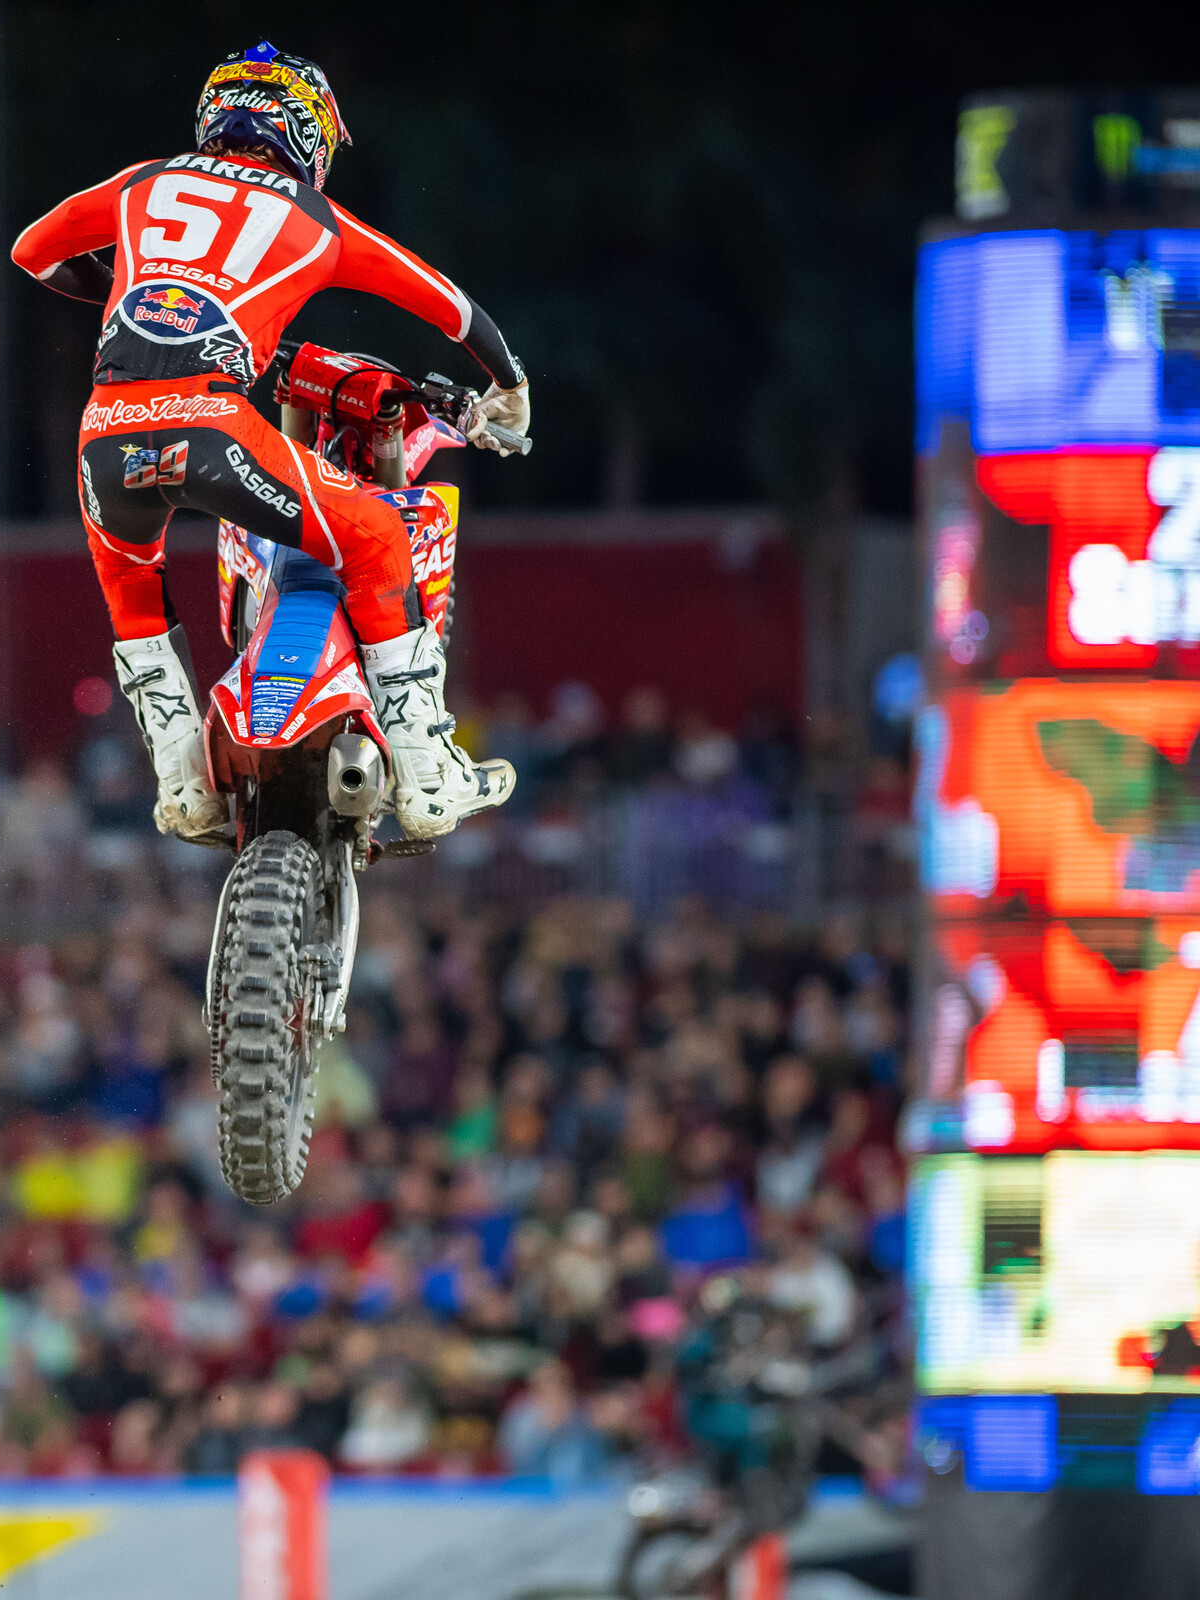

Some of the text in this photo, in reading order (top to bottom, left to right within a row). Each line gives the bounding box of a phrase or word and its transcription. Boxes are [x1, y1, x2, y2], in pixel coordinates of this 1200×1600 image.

[210, 88, 281, 114] Justin
[165, 154, 298, 198] BARCIA
[139, 174, 293, 284] 51
[139, 262, 235, 292] GASGAS
[134, 305, 199, 334] Red Bull
[294, 377, 368, 410] RENTHAL
[82, 393, 238, 432] Troy Lee Designs
[123, 439, 189, 489] 69
[225, 443, 302, 519] GASGAS
[146, 640, 164, 653] 51
[366, 649, 380, 661] 51
[280, 711, 307, 741] DUNLOP
